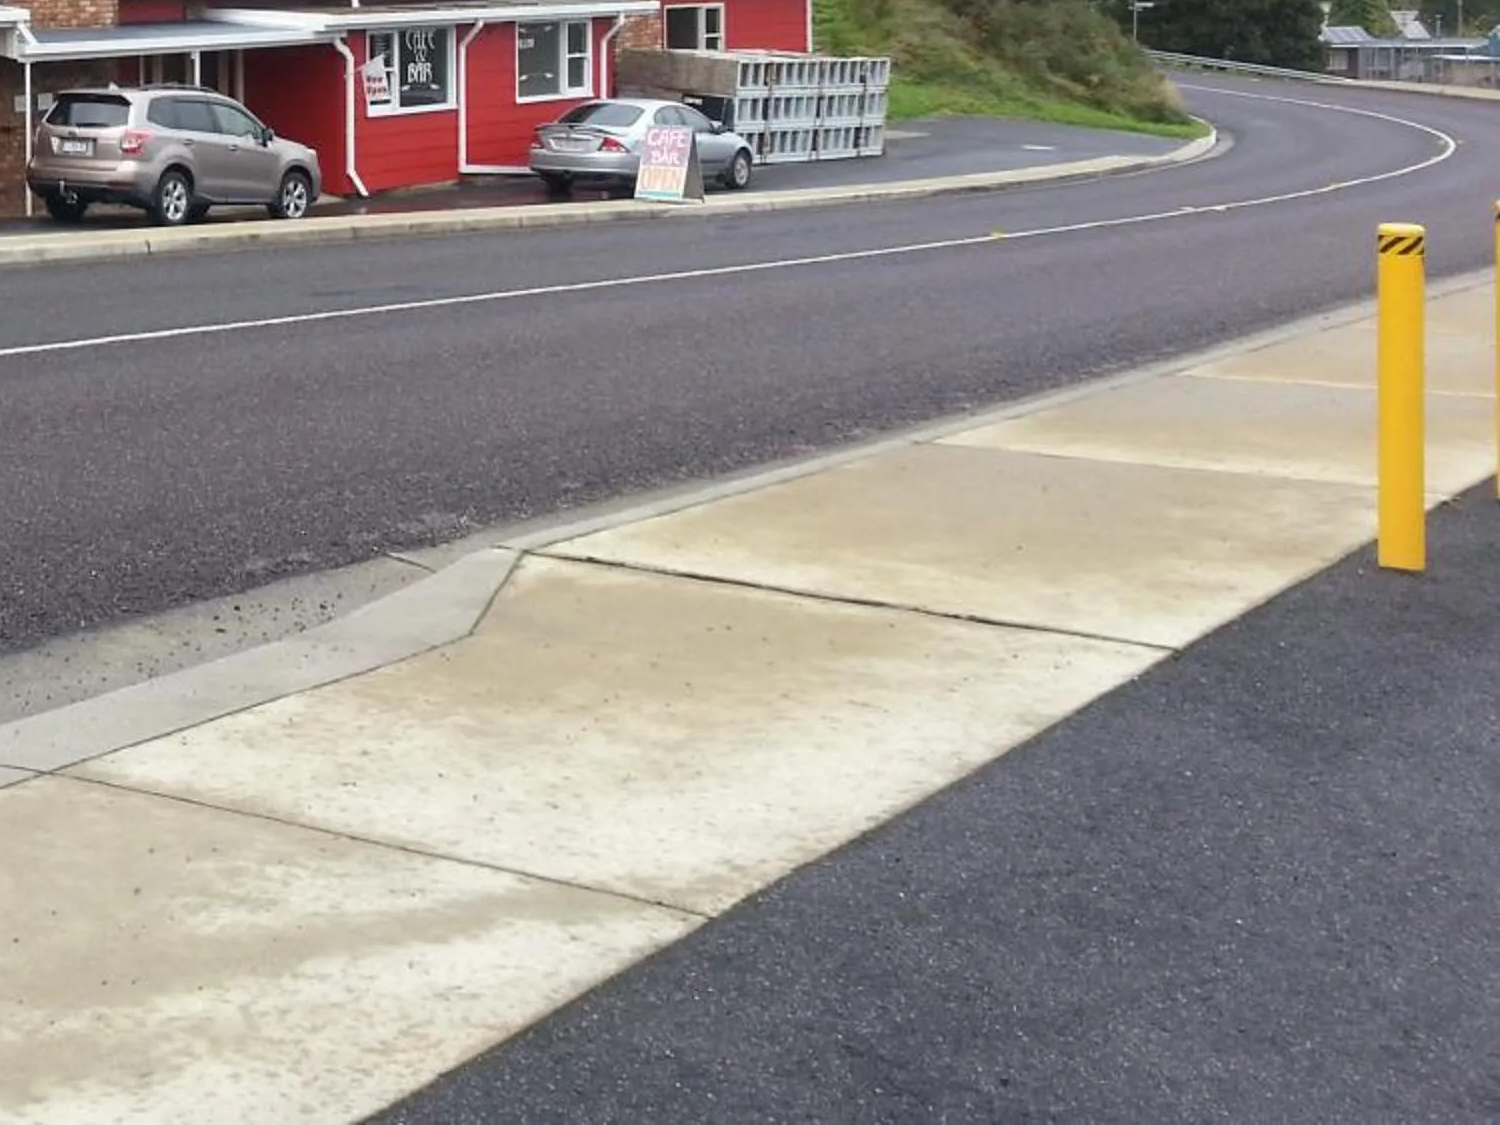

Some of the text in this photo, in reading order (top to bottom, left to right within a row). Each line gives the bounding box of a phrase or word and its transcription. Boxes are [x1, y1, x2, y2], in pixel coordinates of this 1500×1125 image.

[407, 62, 433, 84] BAR
[647, 127, 686, 148] CAFE
[650, 146, 681, 166] BAR
